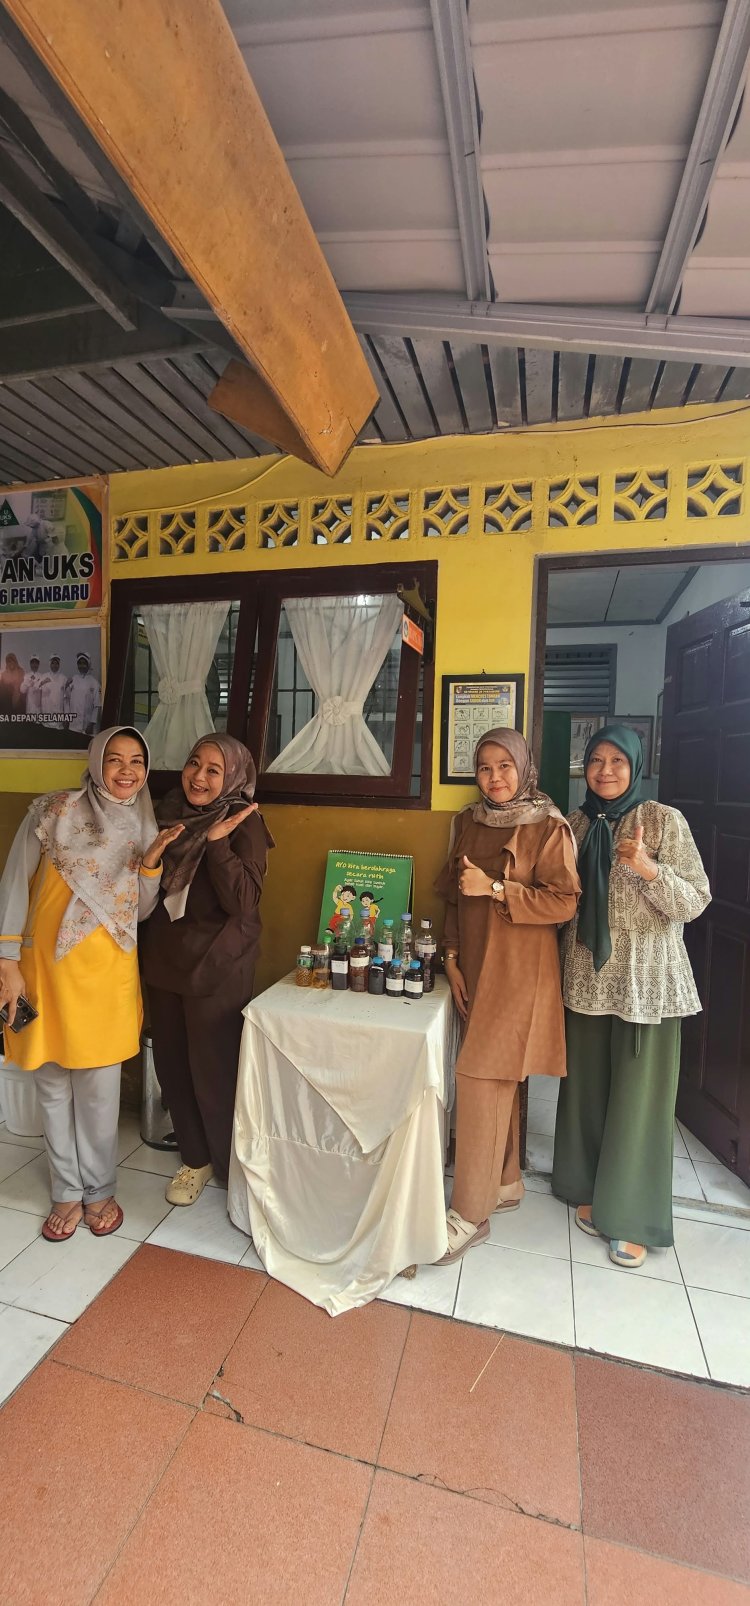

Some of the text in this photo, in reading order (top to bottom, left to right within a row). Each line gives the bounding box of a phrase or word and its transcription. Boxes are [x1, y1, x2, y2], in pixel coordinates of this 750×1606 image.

[1, 552, 94, 583] AN UKS
[10, 583, 90, 604] PEKANBARU
[11, 714, 37, 722] DEPAN
